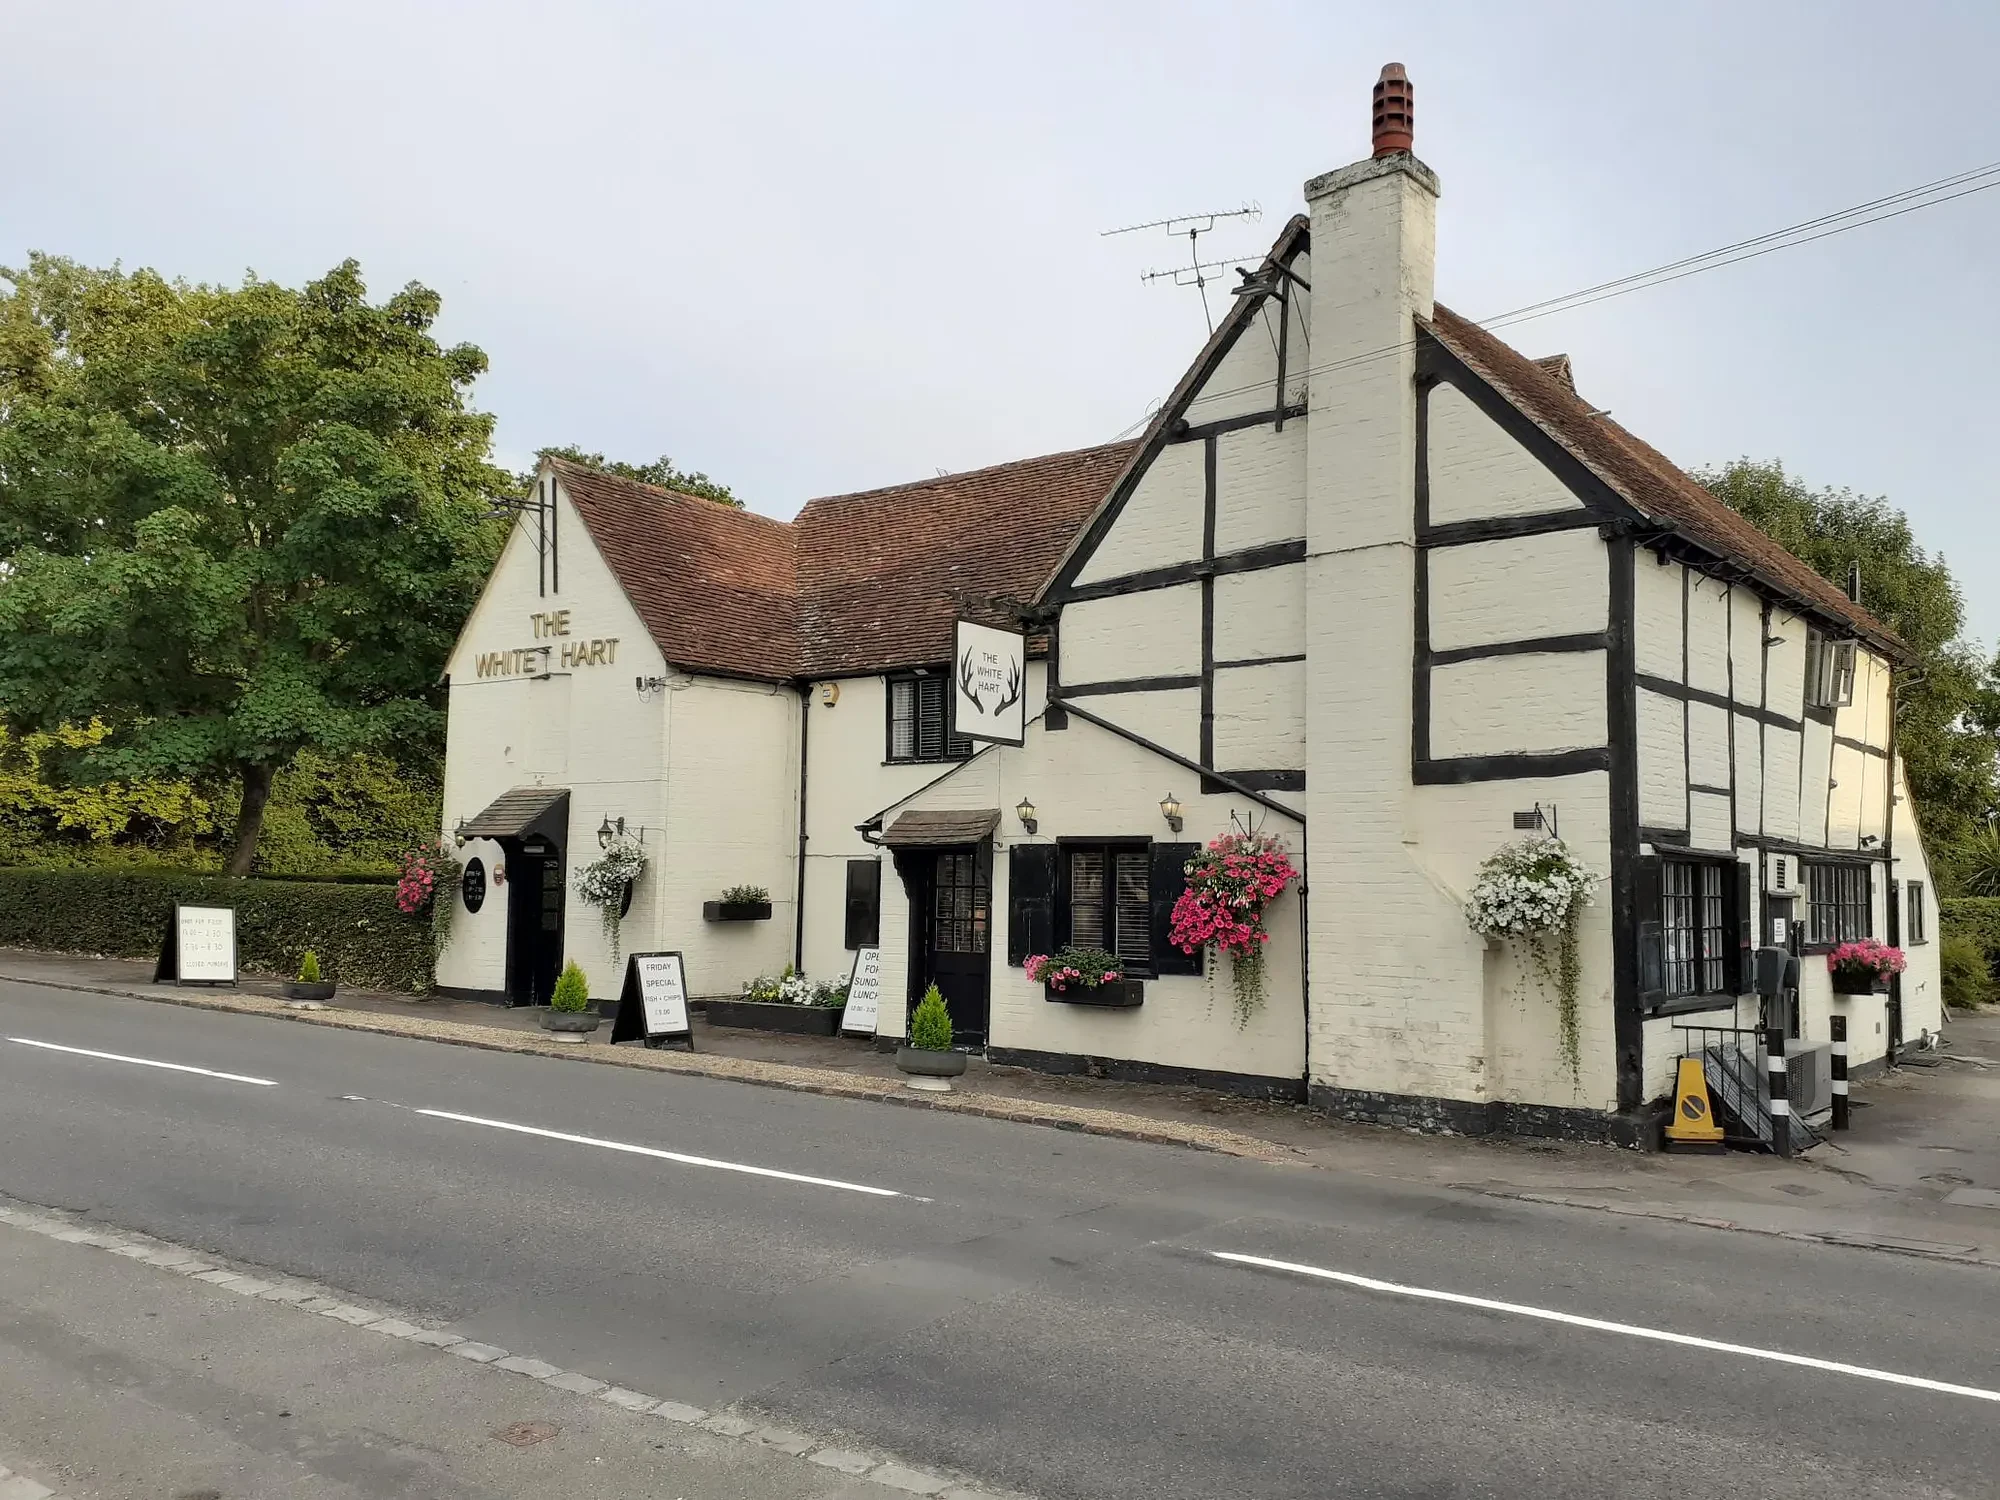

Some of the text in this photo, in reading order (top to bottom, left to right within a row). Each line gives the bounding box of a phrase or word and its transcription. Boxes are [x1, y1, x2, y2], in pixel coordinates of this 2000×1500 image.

[530, 609, 571, 638] THE
[475, 638, 619, 678] WHITE HART
[982, 652, 998, 665] THE
[977, 666, 1002, 680] WHITE
[978, 681, 1000, 693] HART
[865, 952, 879, 961] OPE
[646, 963, 672, 971] FRIDAY
[645, 979, 676, 987] SPECIAL
[854, 977, 879, 986] SUND
